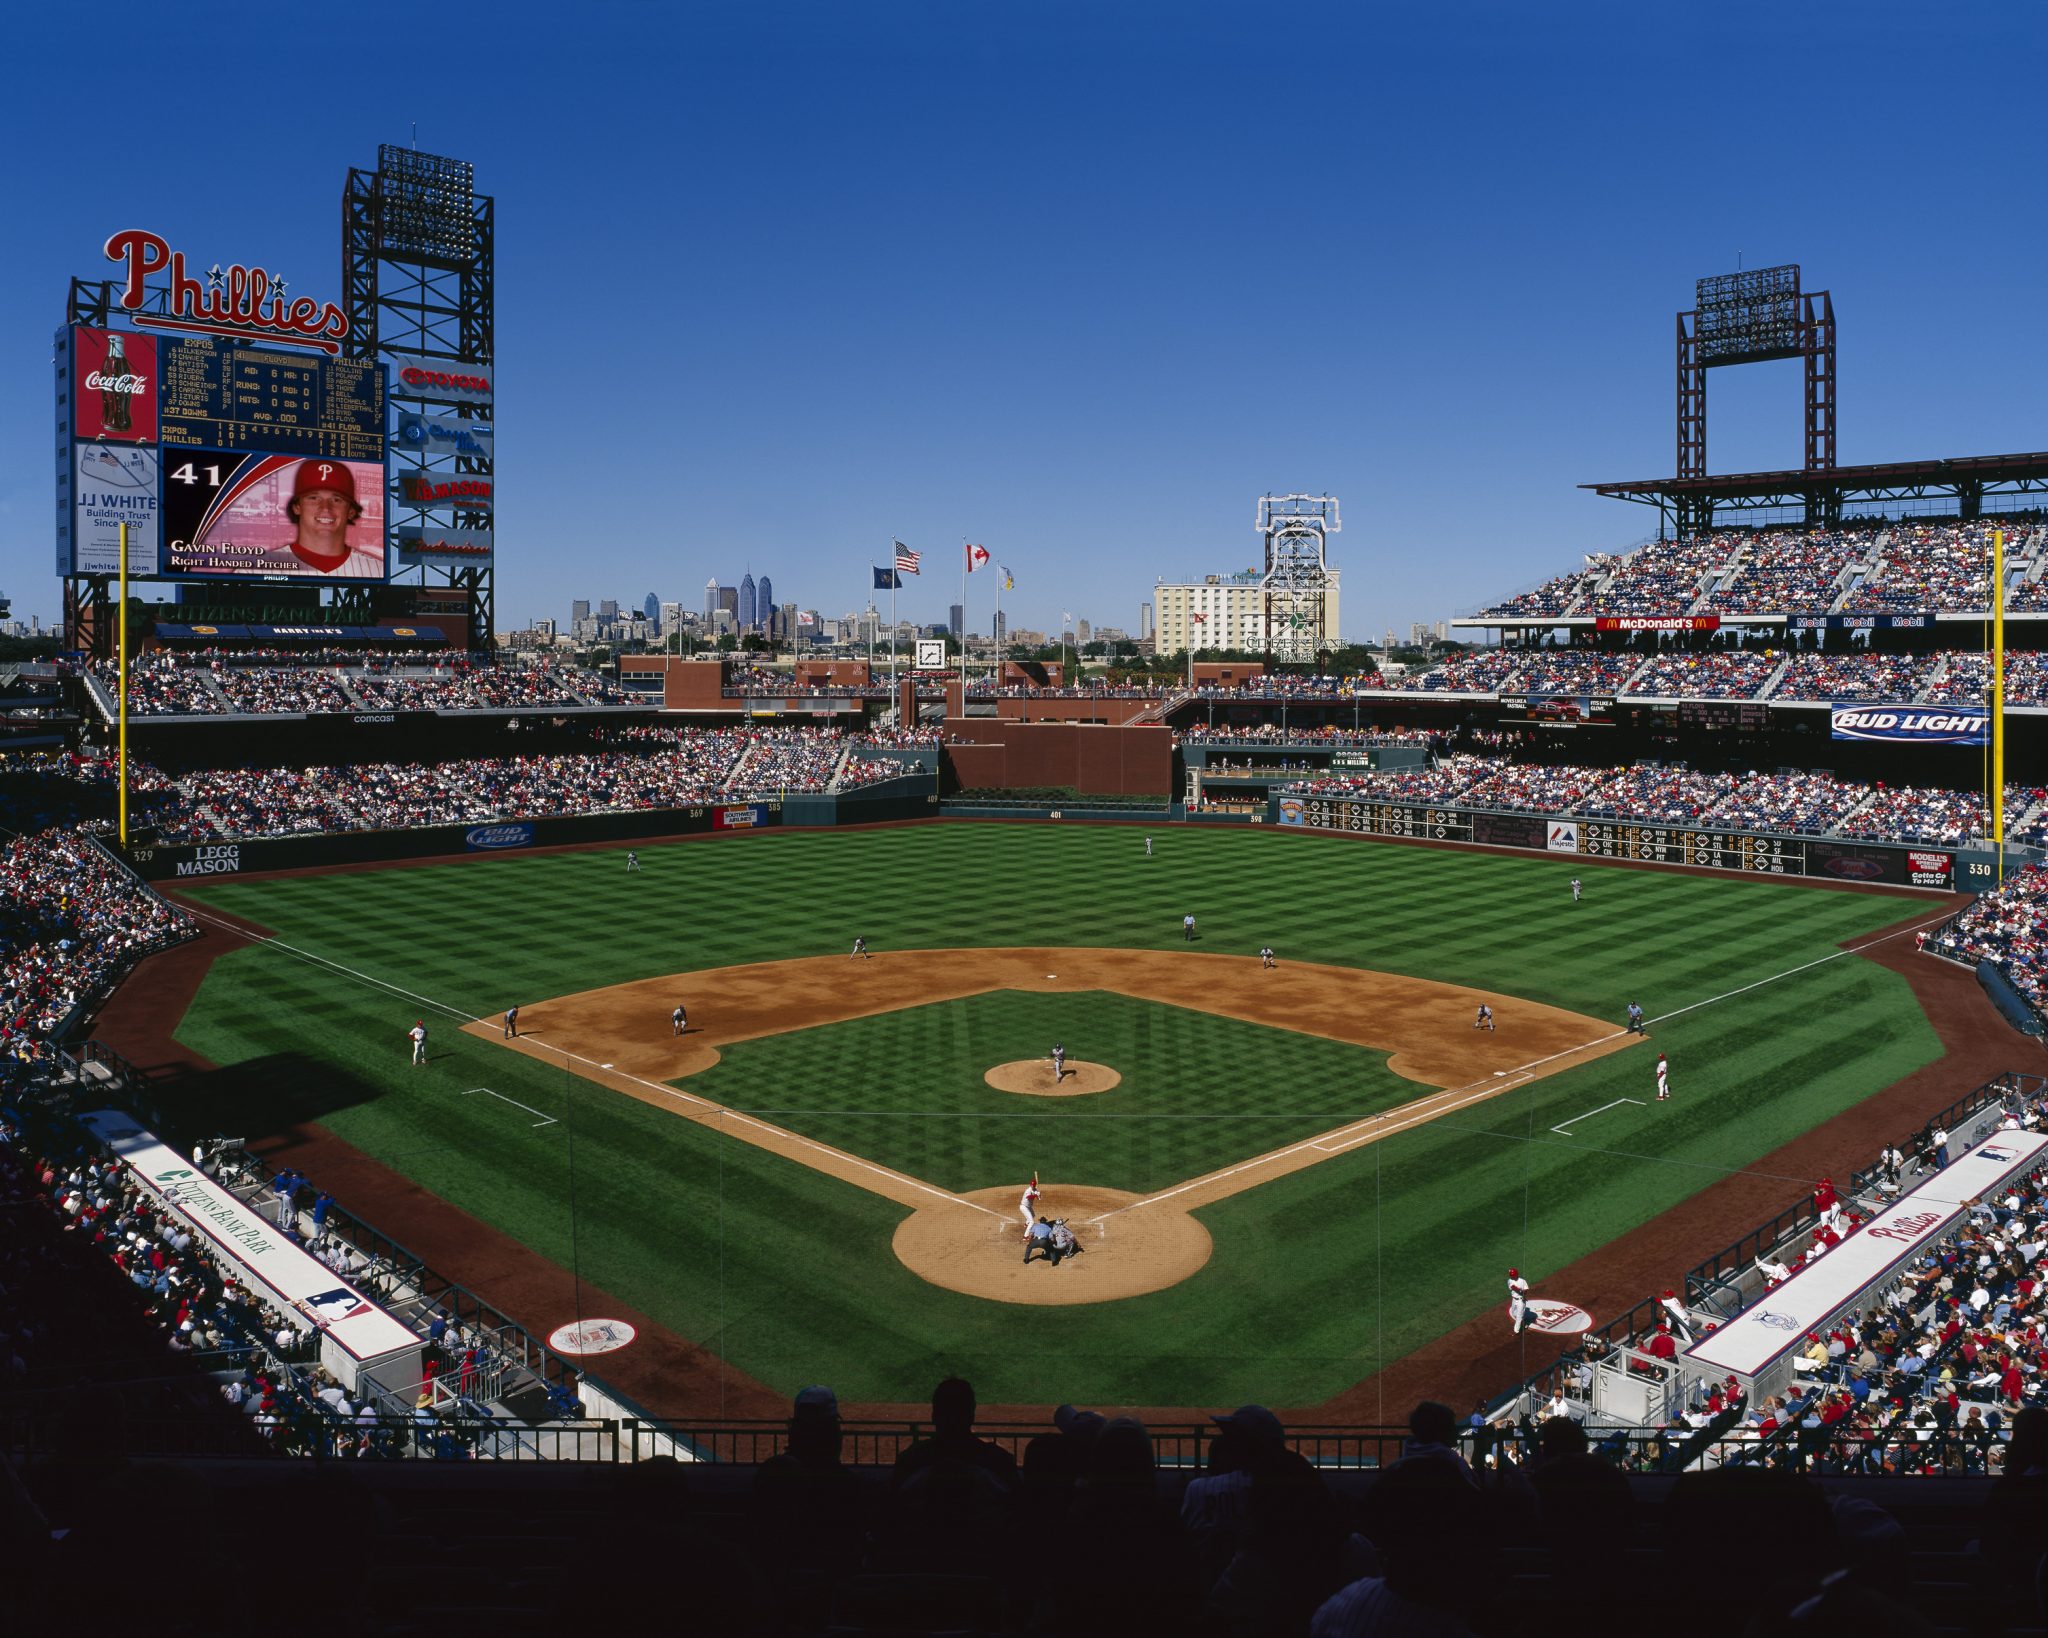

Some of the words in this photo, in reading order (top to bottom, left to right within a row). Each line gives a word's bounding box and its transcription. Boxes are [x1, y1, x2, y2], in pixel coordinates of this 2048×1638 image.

[104, 229, 349, 339] Phillies
[184, 338, 214, 349] EXPOS
[264, 356, 288, 364] FLOYD
[333, 358, 374, 368] PHILLIES
[236, 382, 260, 390] RUNS:
[424, 370, 490, 392] TOYOTA
[178, 387, 208, 395] CARROLL
[240, 396, 260, 404] HITS:
[182, 408, 208, 416] DOWNS
[162, 426, 187, 434] EXPOS
[338, 423, 360, 432] FLOYD
[162, 434, 202, 444] PHILLIES
[170, 463, 220, 486] 41
[318, 464, 332, 480] P
[78, 493, 96, 506] JJ
[101, 494, 156, 510] WHITE
[86, 509, 125, 520] Building
[128, 511, 150, 520] Trust
[94, 519, 118, 528] Since
[1620, 618, 1692, 628] McDonald's
[1797, 618, 1826, 627] Mobil
[1844, 617, 1874, 627] Mobil
[1892, 616, 1924, 626] Mobil
[1246, 636, 1308, 648] CITIZENS
[1312, 637, 1349, 650] BANK
[1280, 650, 1314, 664] PARK
[354, 714, 394, 722] comcast
[1836, 713, 1898, 728] BUD
[1900, 716, 1990, 732] LIGHT
[768, 802, 780, 812] 385
[690, 808, 704, 818] 369
[484, 826, 522, 836] BUD
[476, 834, 530, 844] LIGHT
[1550, 840, 1574, 848] Majestic
[134, 850, 153, 862] 329
[196, 845, 240, 860] LEGG
[1910, 852, 1948, 862] MODELL'S
[176, 858, 240, 876] MASON
[1969, 864, 1990, 876] 330
[210, 1209, 246, 1234] BANK
[234, 1229, 276, 1255] PARK
[1868, 1212, 1942, 1242] Phillies
